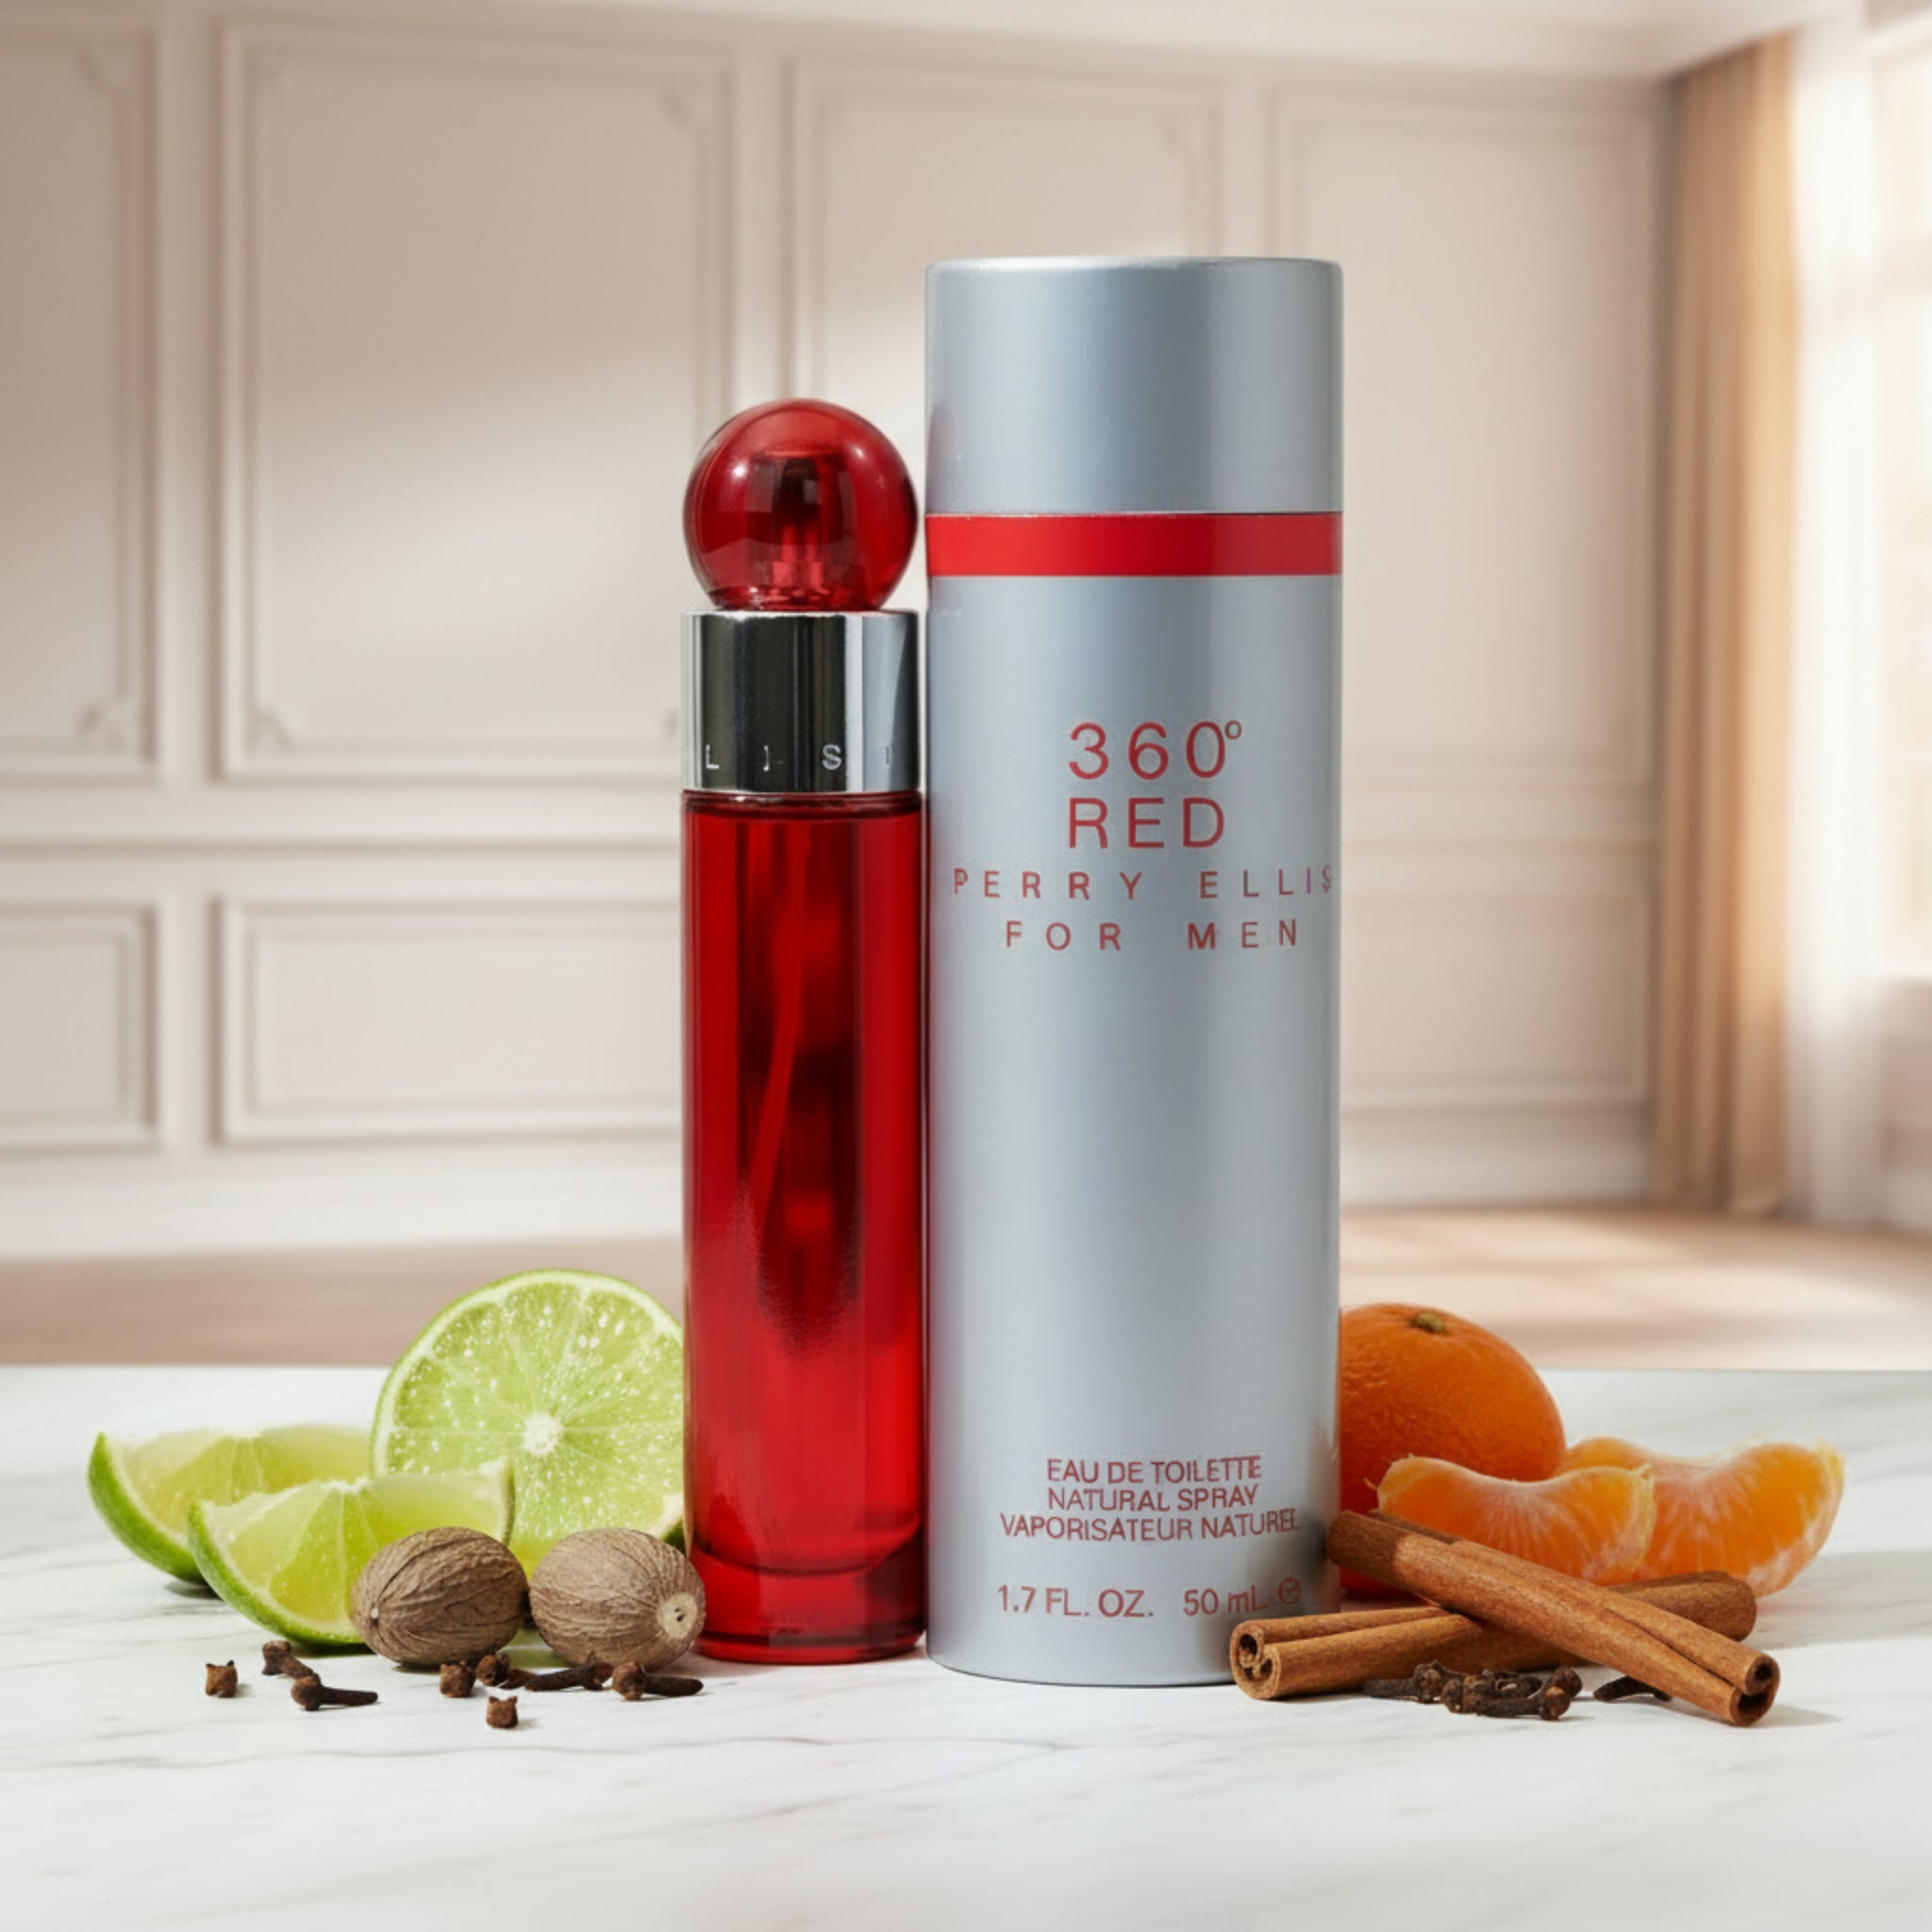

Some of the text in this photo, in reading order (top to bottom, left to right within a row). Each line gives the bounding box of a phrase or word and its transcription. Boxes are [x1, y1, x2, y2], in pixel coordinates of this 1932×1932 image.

[1069, 797, 1224, 848] RED
[954, 865, 1331, 900] PERRY ELLIS
[1006, 919, 1296, 951] FOR MEN
[1047, 1455, 1261, 1484] EAU DE TOILETTE
[1048, 1484, 1258, 1511] NATURAL SPRAY
[1000, 1513, 1192, 1541] VAPORISATEUR
[998, 1585, 1037, 1613] 1.7
[1045, 1588, 1090, 1617] FL.
[1098, 1589, 1154, 1618] OZ.
[1183, 1589, 1219, 1616] 50
[1227, 1585, 1269, 1613] mL
